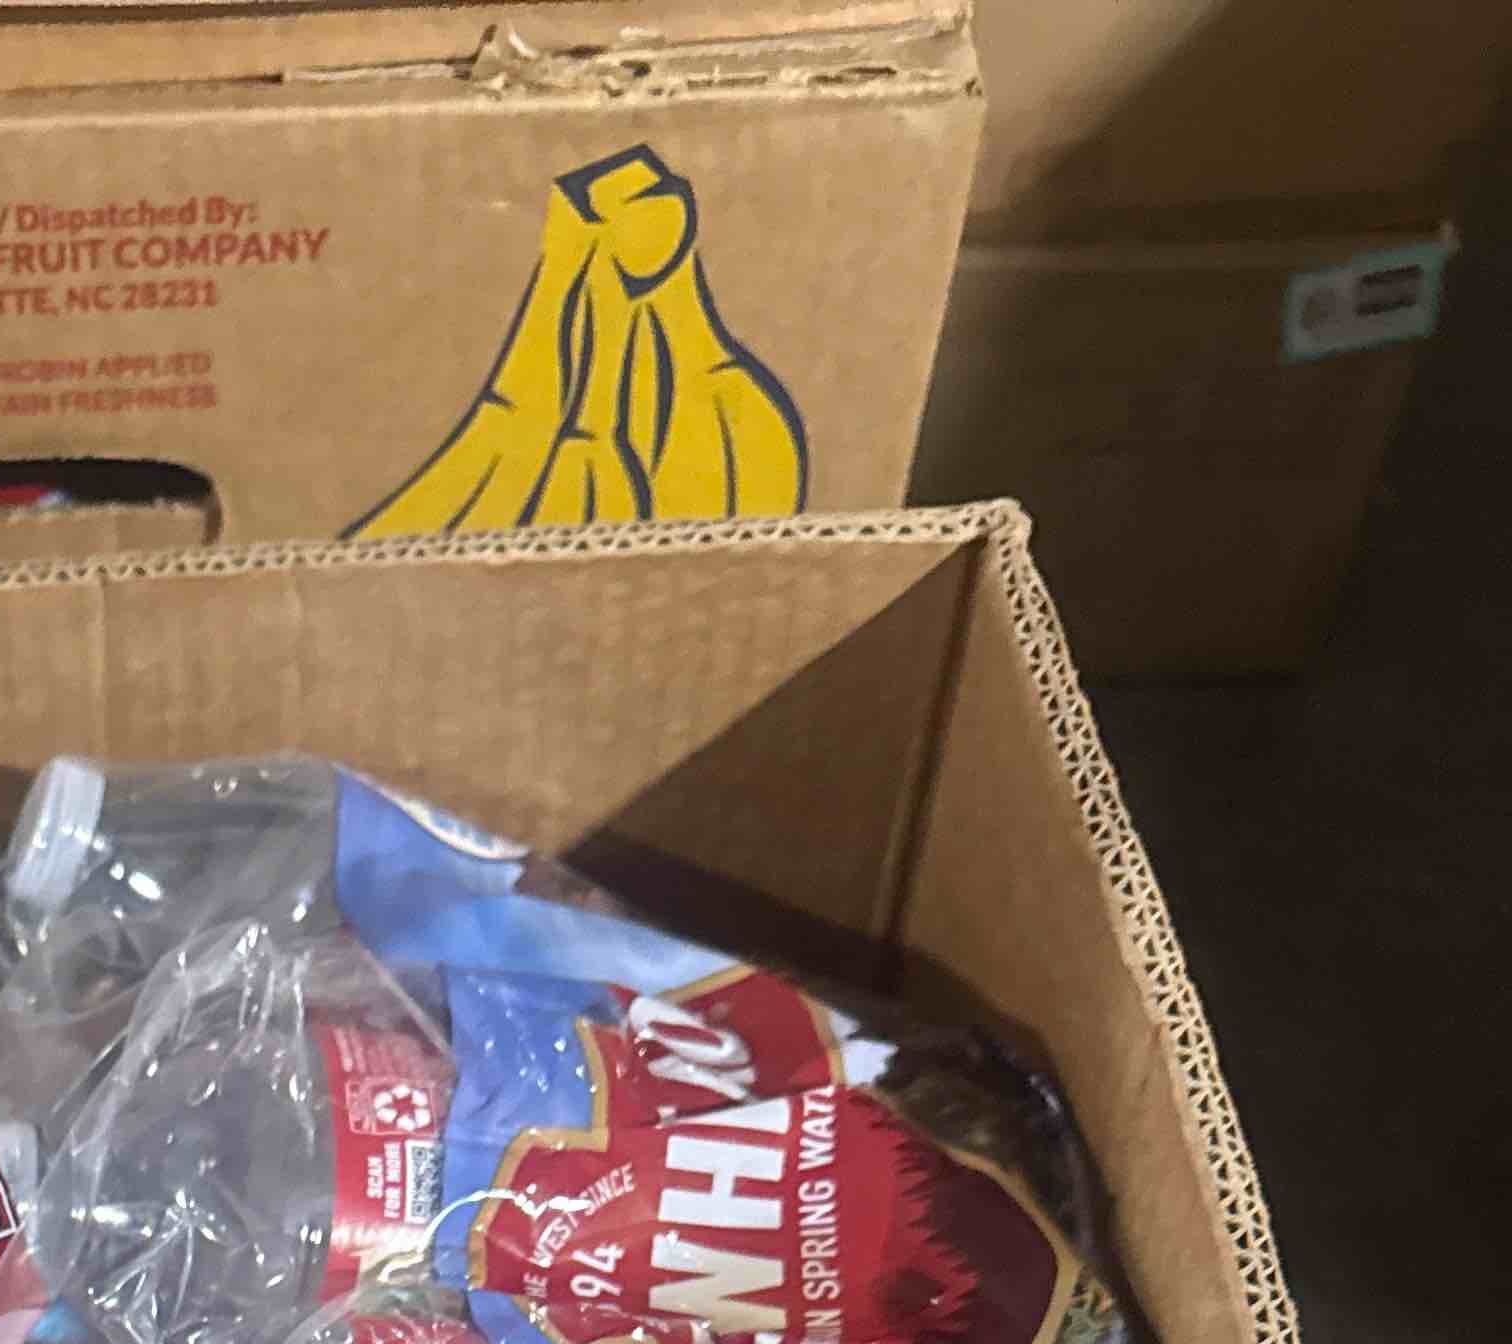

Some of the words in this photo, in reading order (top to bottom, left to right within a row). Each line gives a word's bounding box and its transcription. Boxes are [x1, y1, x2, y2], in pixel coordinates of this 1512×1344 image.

[15, 196, 198, 234] Dispatched
[204, 195, 259, 230] By:
[112, 227, 330, 270] COMPANY
[64, 284, 115, 312] NC
[799, 1180, 841, 1302] SPRING
